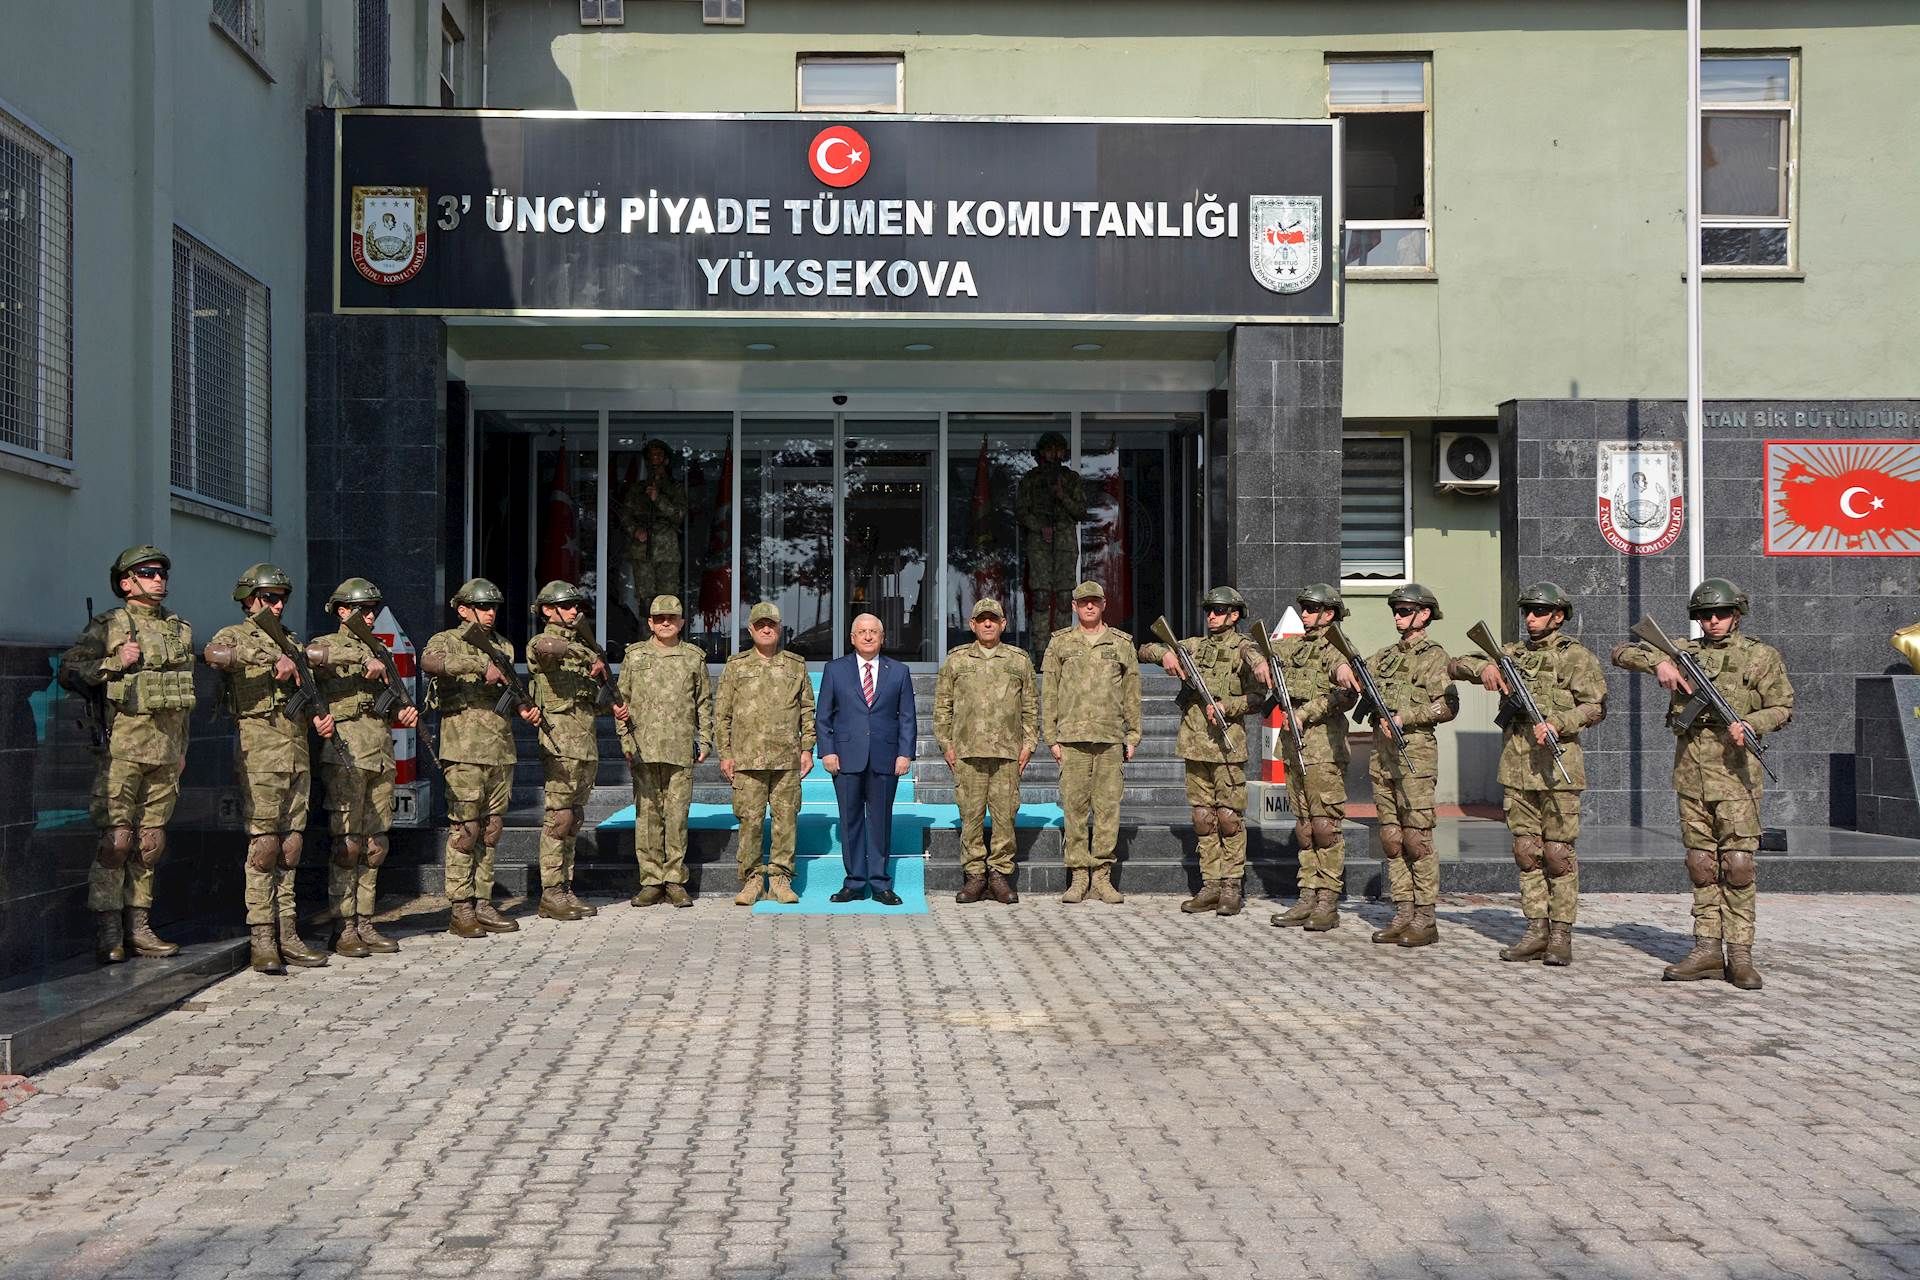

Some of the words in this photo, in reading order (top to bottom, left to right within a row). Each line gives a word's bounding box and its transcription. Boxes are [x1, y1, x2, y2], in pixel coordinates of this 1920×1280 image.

[485, 188, 606, 234] ÜNCÜ
[620, 188, 771, 235] PİYADE
[784, 191, 933, 237] TÜMEN
[947, 193, 1239, 239] KOMUTANLIĞI
[358, 262, 381, 281] ORDU
[697, 251, 978, 298] YÜKSEKOVA
[1754, 407, 1788, 428] BİR
[1794, 408, 1908, 428] BÜTÜNDÜR
[1607, 532, 1632, 552] ORDU
